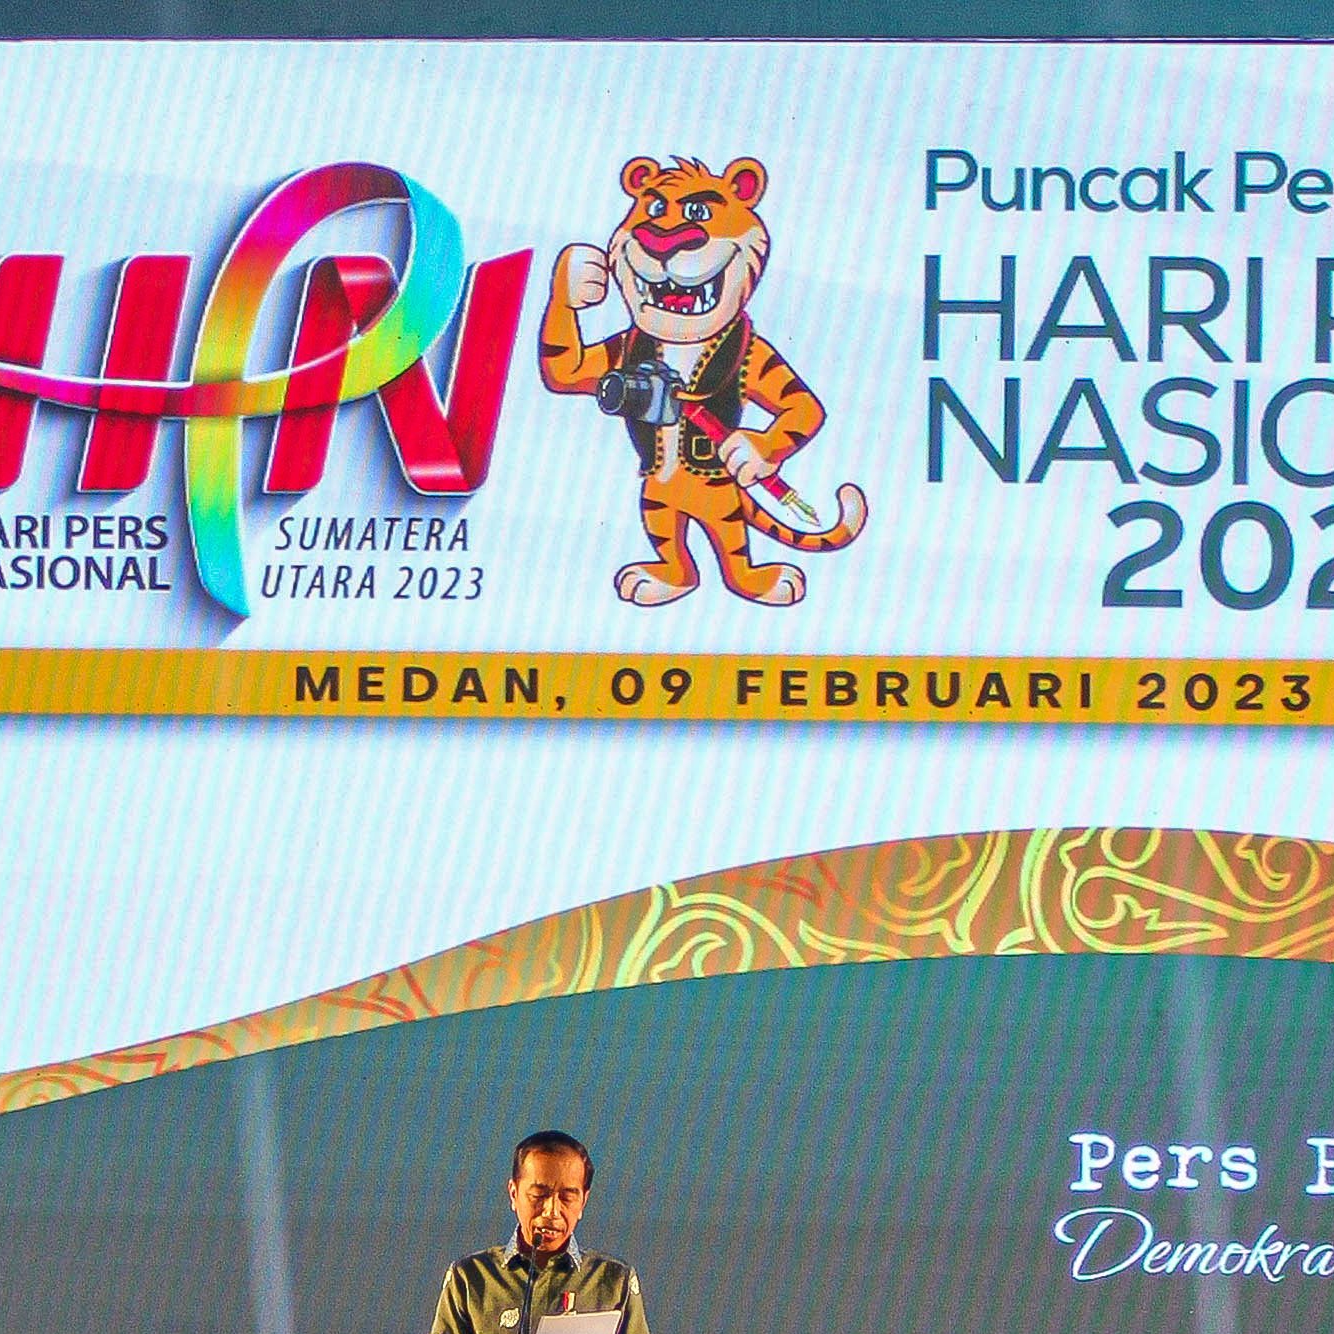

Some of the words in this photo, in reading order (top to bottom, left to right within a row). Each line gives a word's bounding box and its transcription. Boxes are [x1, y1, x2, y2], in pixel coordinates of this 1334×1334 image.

[924, 149, 1215, 213] Puncak
[923, 254, 1264, 364] HARI
[65, 515, 169, 551] PERS
[275, 516, 470, 553] SUMATERA
[261, 564, 376, 600] UTARA
[393, 565, 485, 601] 2023
[295, 665, 567, 711] MEDAN,
[611, 668, 694, 706] 09
[736, 669, 1092, 709] FEBRUARI
[1137, 672, 1312, 712] 2023
[1068, 1132, 1259, 1191] Pers
